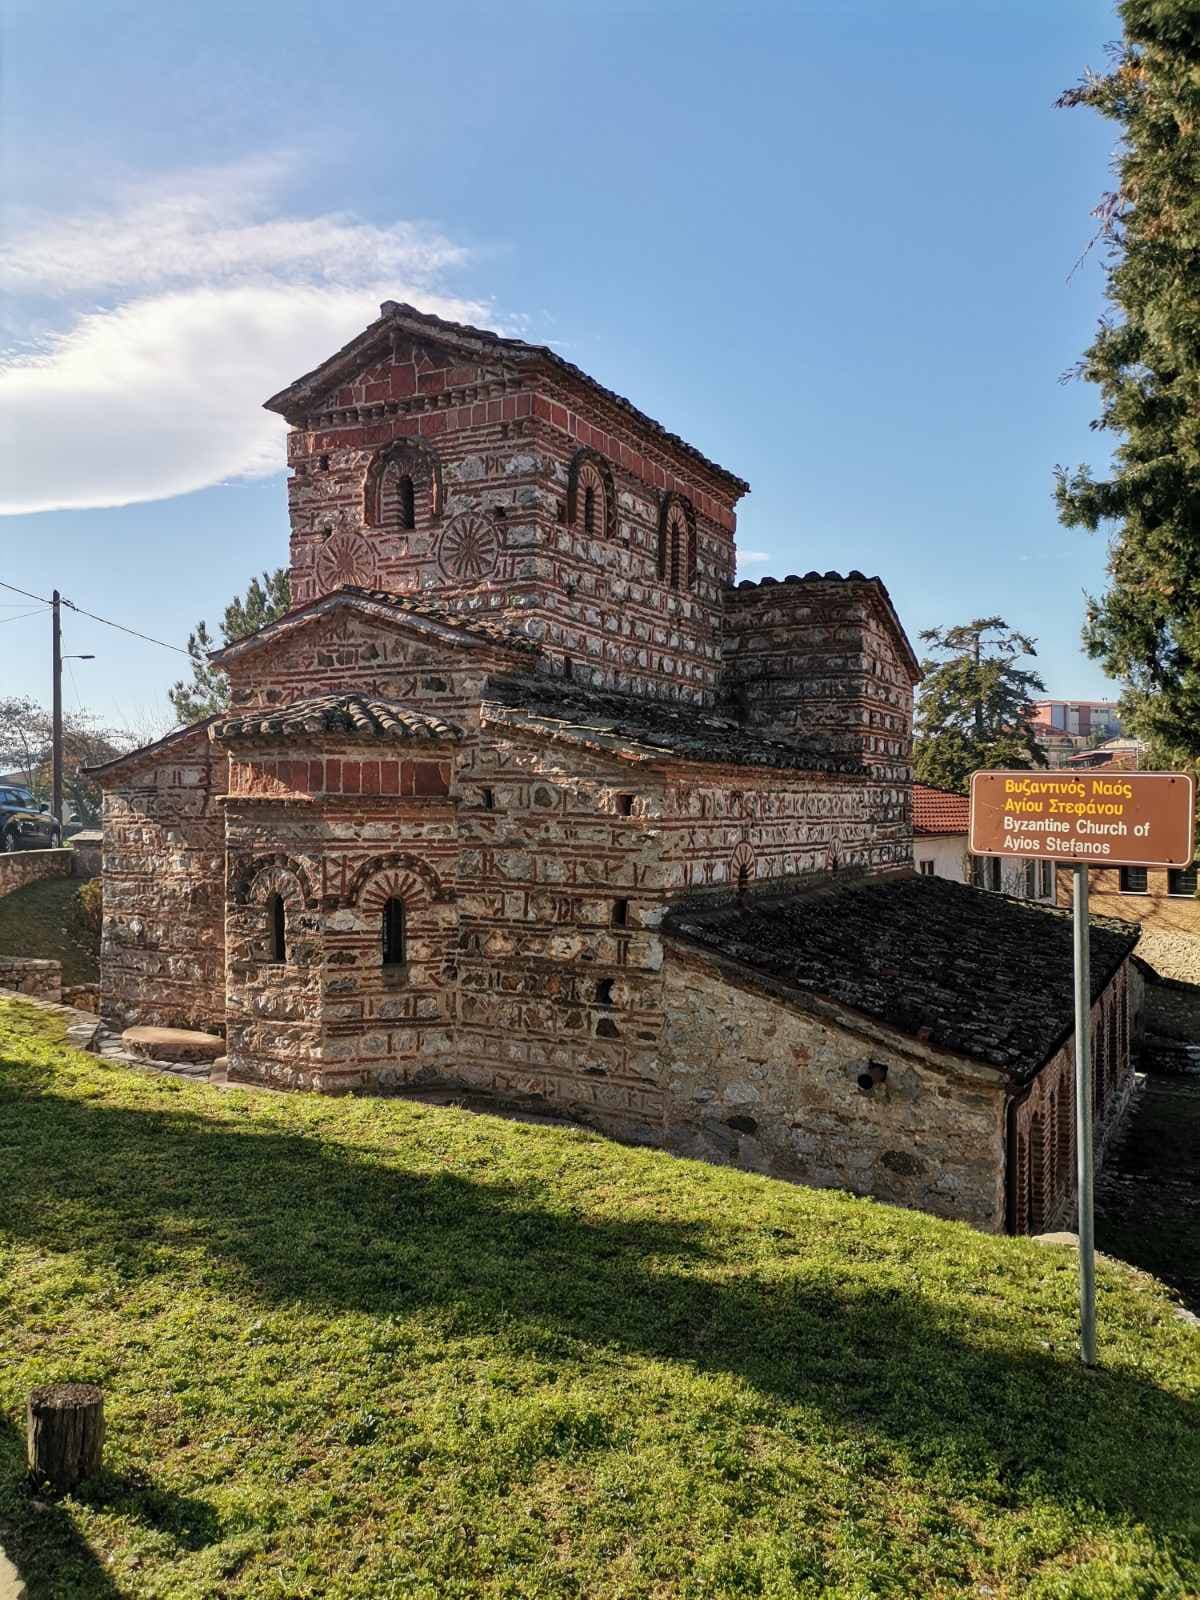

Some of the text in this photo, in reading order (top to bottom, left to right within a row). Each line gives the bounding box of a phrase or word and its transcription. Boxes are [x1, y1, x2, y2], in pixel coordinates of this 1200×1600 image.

[1005, 779, 1132, 798] Βυζαντινός Ναός
[1004, 798, 1123, 816] Αγίου Στεφάνου
[1003, 816, 1151, 837] Byzantine Church of
[1003, 835, 1111, 854] Ayios Stefanos
